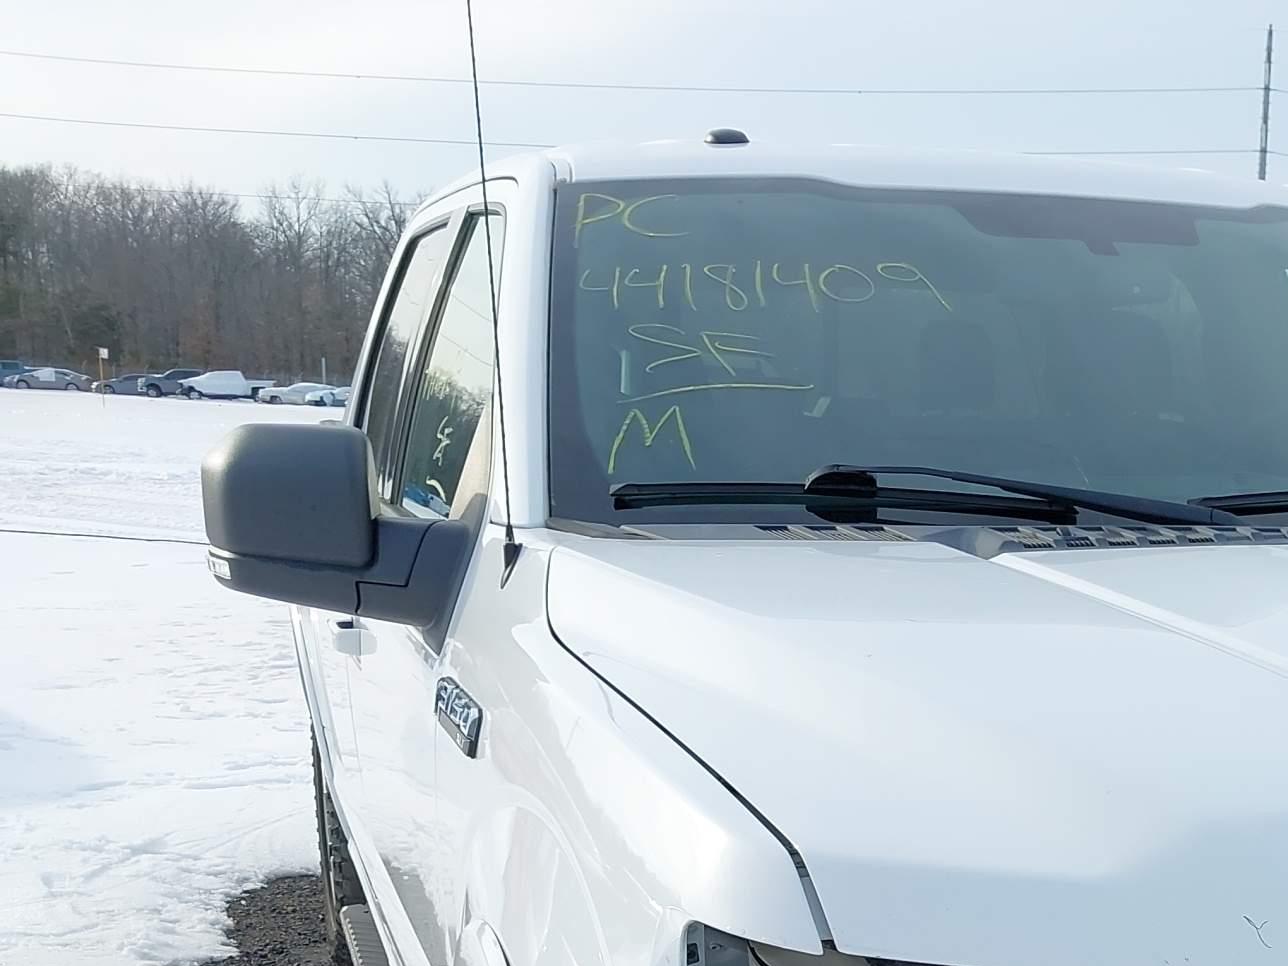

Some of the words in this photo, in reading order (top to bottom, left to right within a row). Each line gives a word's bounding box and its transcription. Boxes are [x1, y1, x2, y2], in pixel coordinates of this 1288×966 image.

[574, 193, 691, 248] PC
[580, 260, 953, 313] 44181409
[607, 405, 697, 475] M
